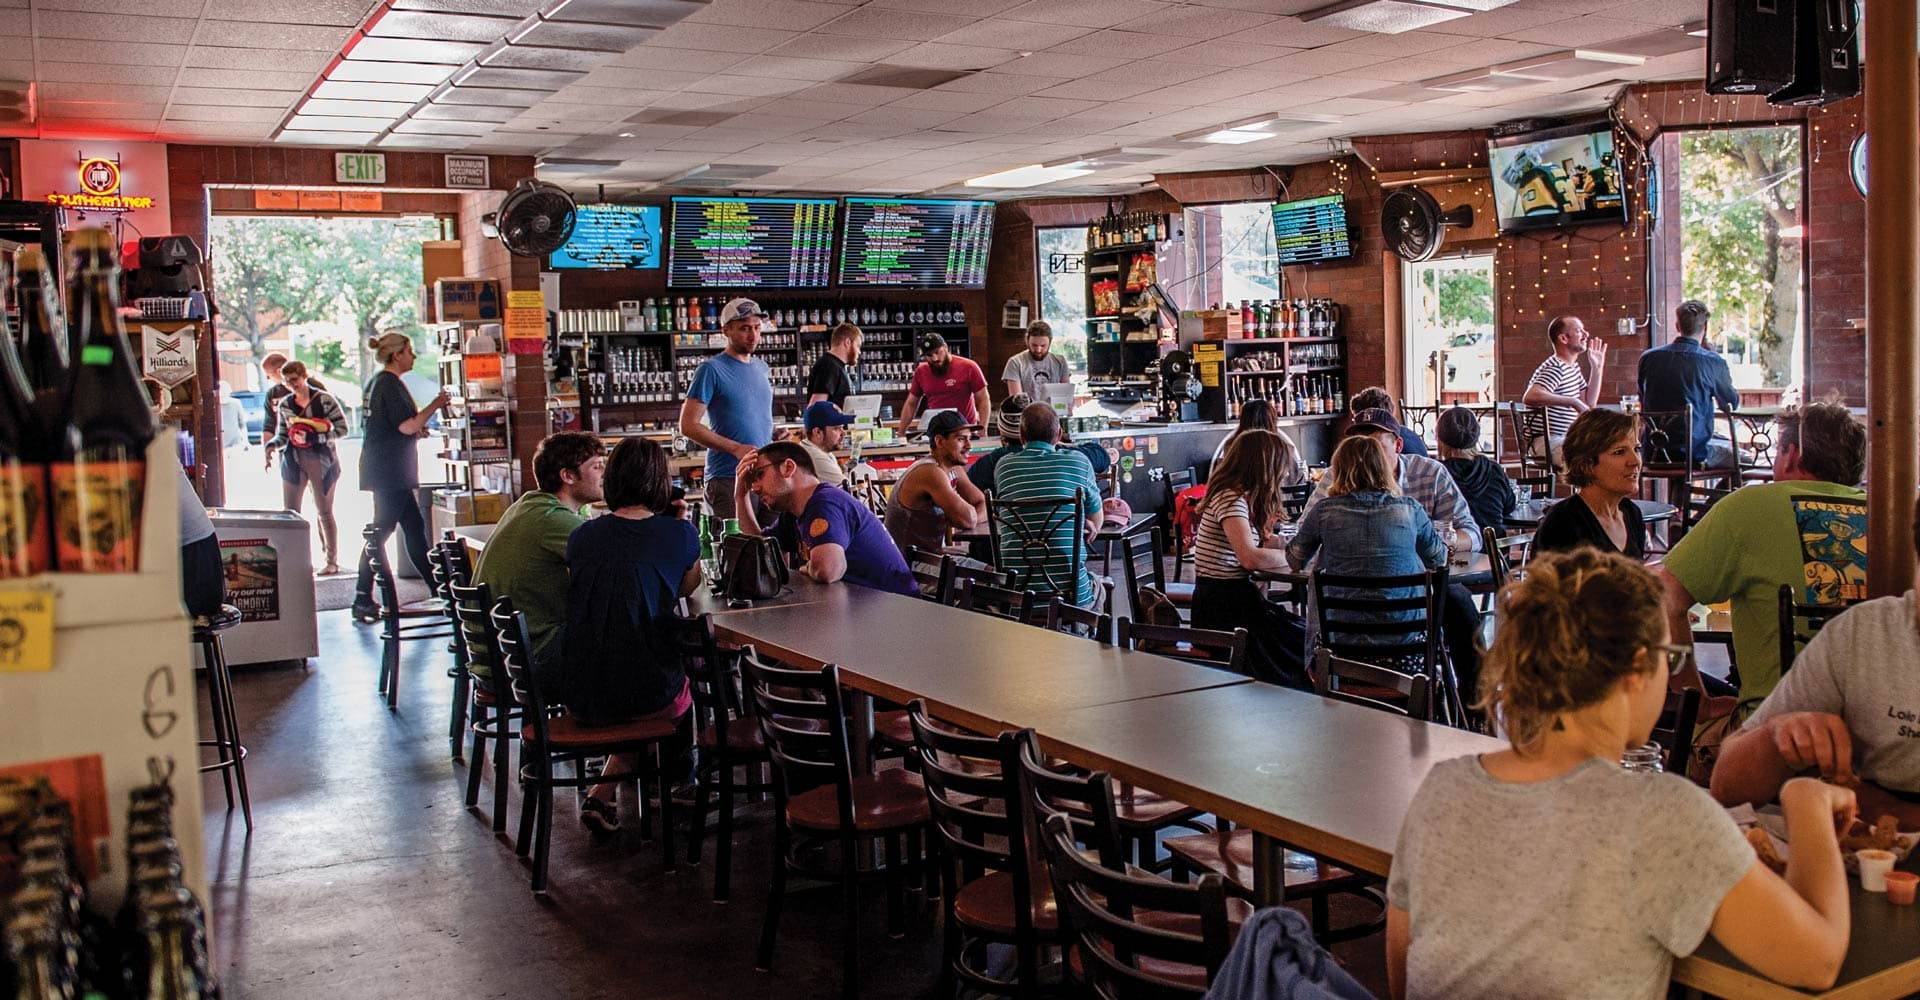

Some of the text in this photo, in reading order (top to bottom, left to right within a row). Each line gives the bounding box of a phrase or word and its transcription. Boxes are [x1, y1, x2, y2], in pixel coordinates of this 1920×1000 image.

[344, 155, 378, 180] EXIT
[449, 160, 484, 168] MAXIMUM
[449, 167, 483, 176] OCCUPANCY
[47, 194, 121, 207] SOUTHERN
[150, 357, 188, 370] Hilliard's
[226, 589, 240, 598] Try
